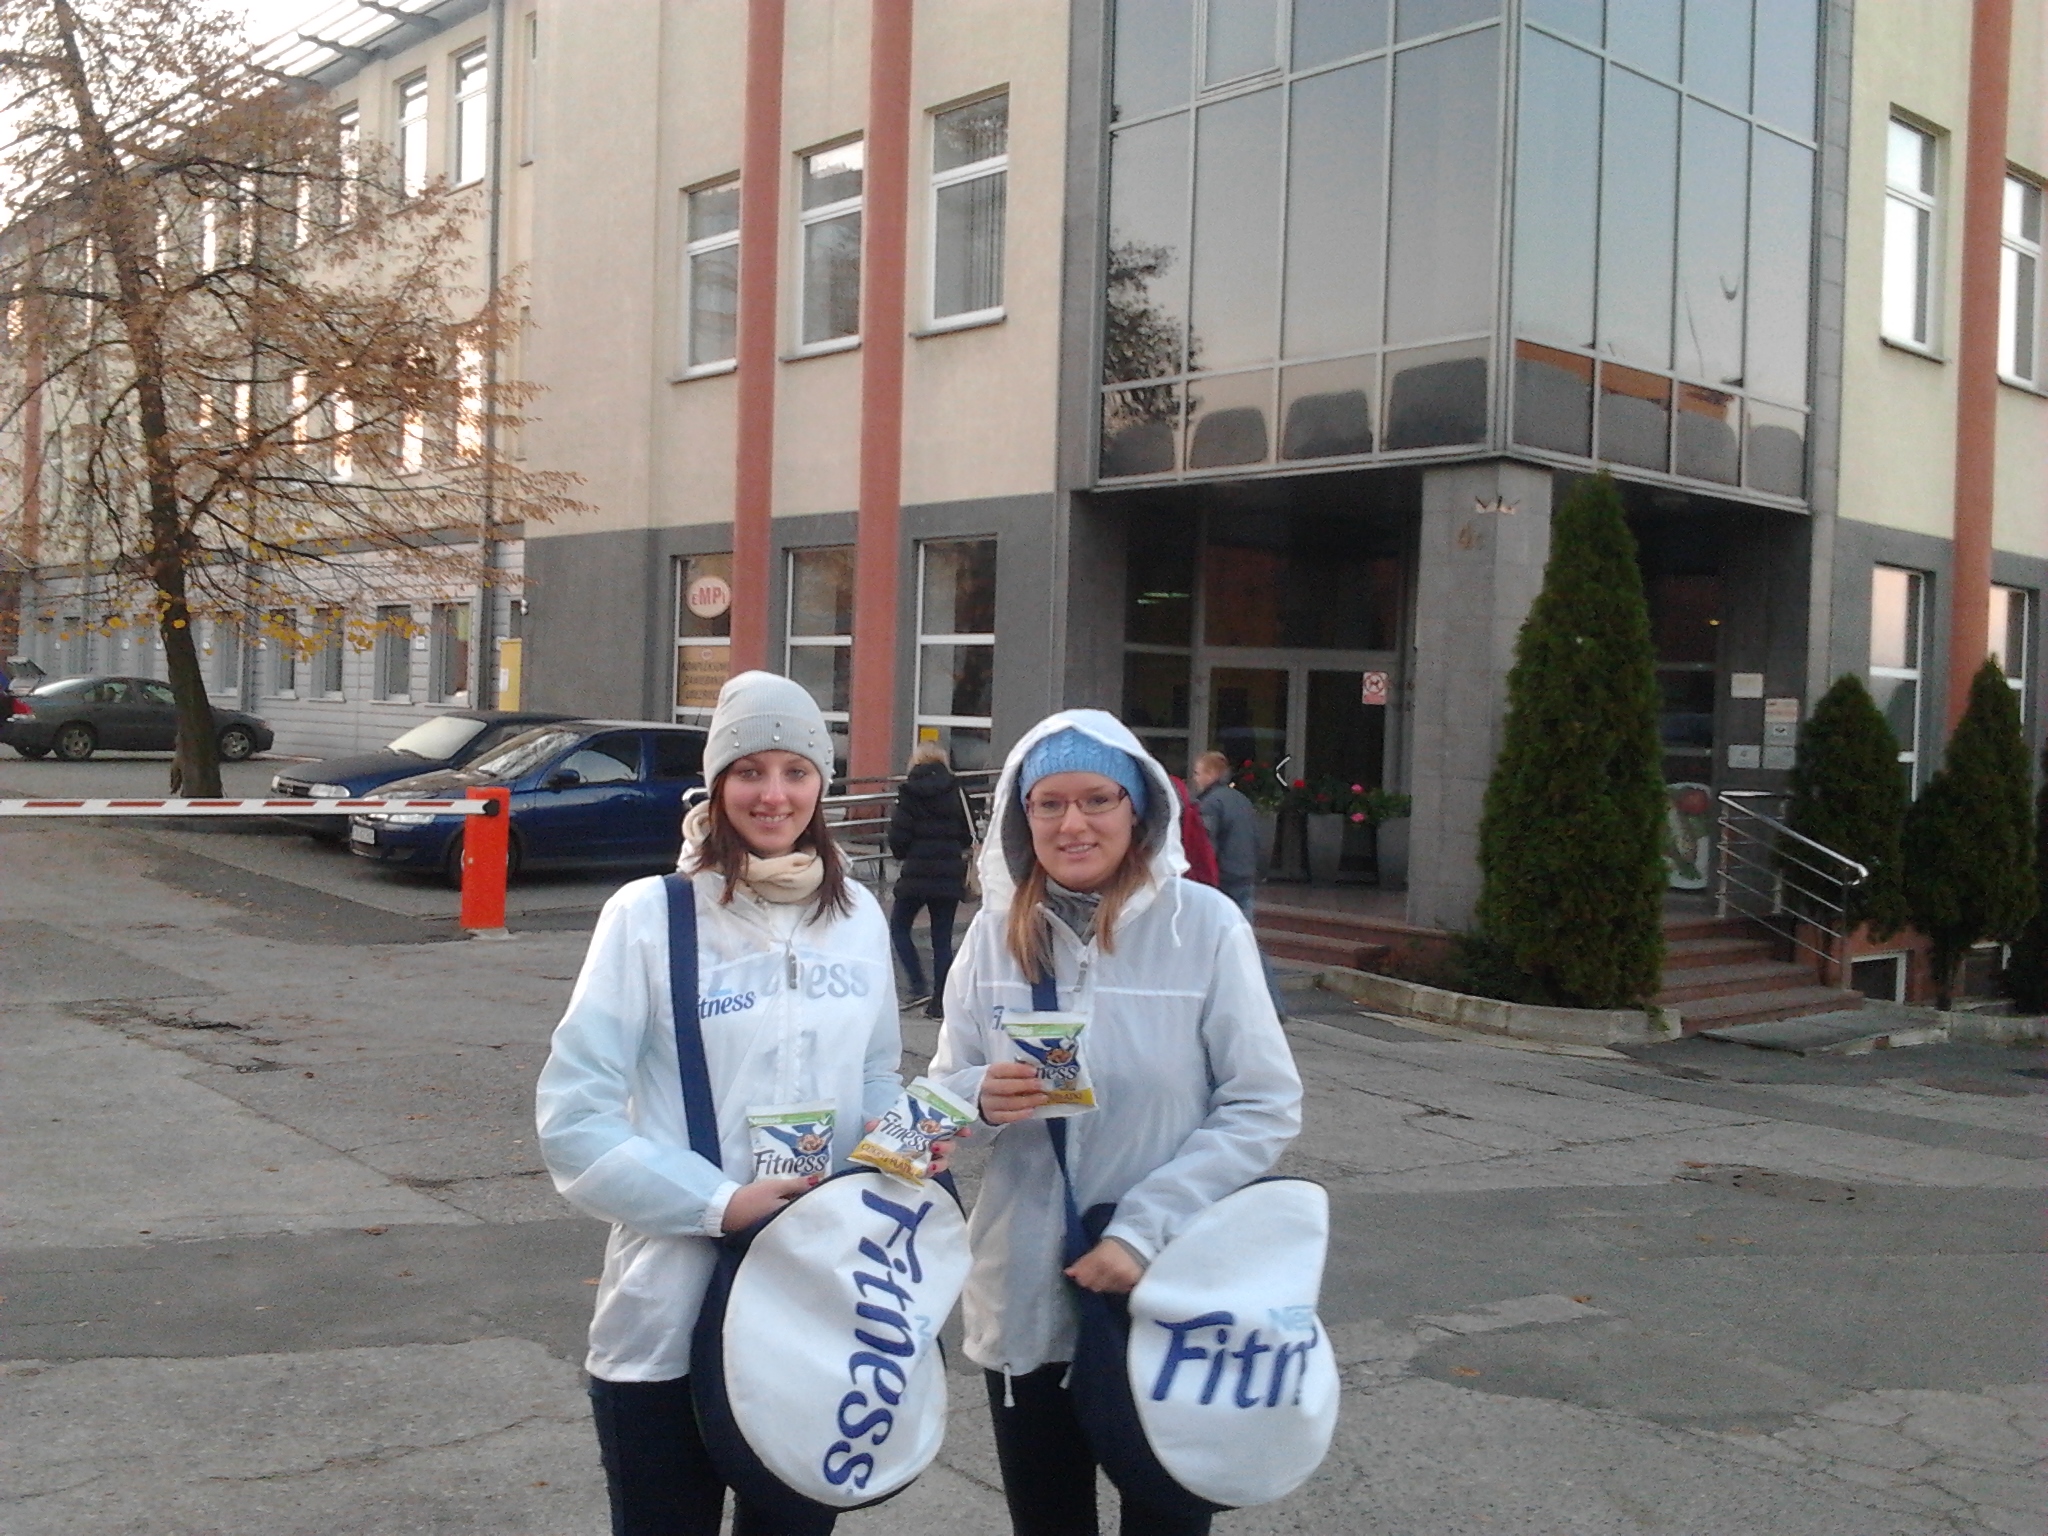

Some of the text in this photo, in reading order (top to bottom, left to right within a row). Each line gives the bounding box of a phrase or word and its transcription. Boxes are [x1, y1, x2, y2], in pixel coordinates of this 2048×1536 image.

[697, 991, 757, 1019] tness
[1036, 1066, 1079, 1080] ness
[881, 1111, 930, 1152] Fitness
[753, 1149, 828, 1175] Fitness
[822, 1188, 933, 1489] Fitness
